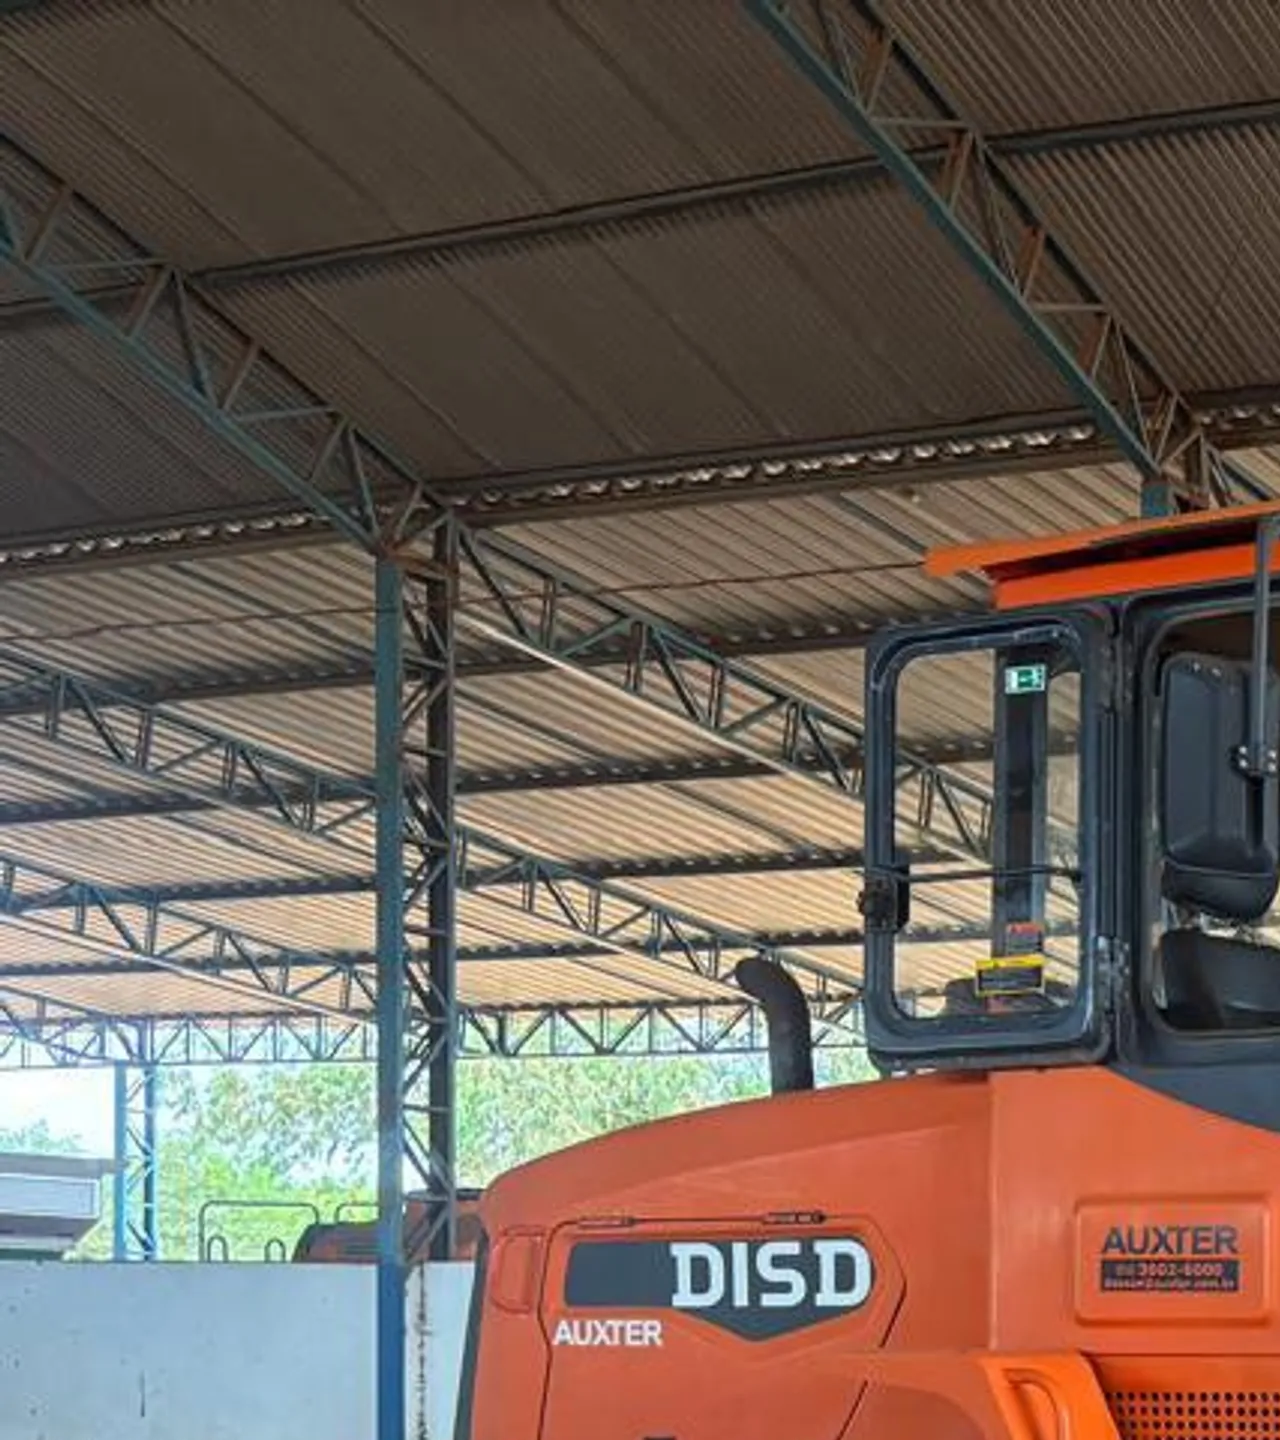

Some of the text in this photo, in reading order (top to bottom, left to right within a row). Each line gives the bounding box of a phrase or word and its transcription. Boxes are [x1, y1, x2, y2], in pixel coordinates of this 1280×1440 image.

[1101, 1224, 1240, 1254] AUXTER
[669, 1240, 872, 1308] DISD
[552, 1319, 663, 1346] AUXTER
